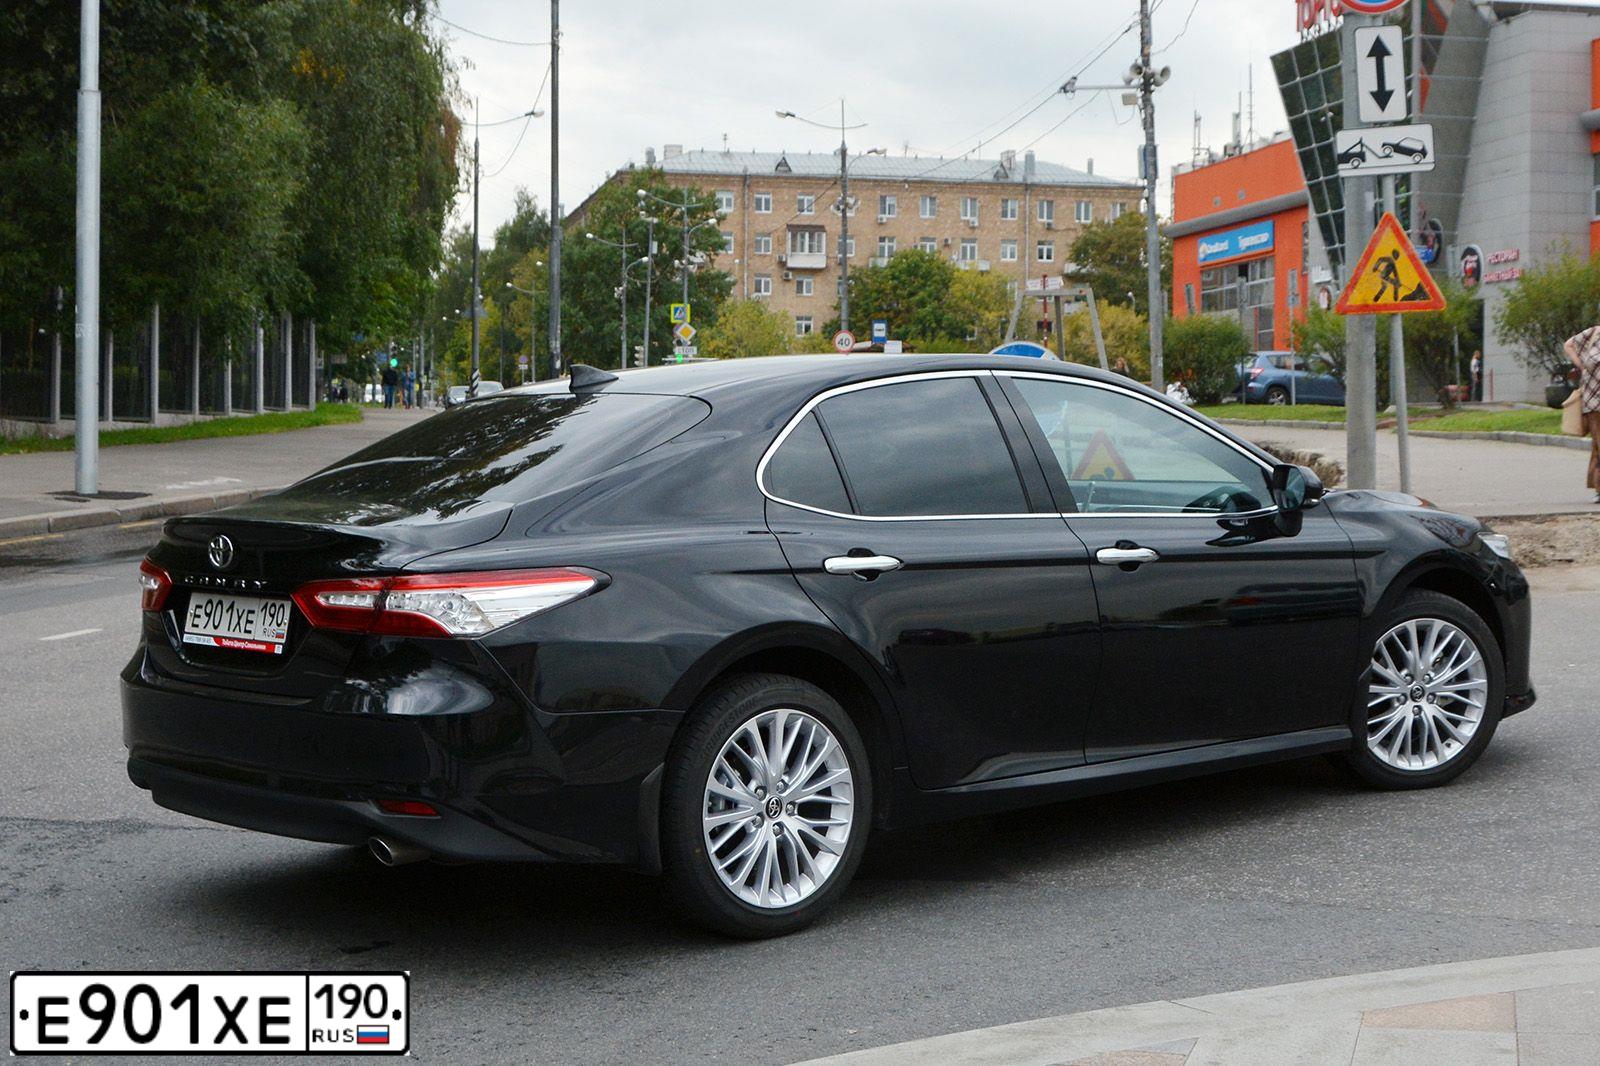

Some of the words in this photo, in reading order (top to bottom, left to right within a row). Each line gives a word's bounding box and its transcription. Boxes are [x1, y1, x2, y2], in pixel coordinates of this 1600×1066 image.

[837, 336, 850, 347] 40
[261, 601, 285, 628] 190
[263, 628, 276, 638] RUS
